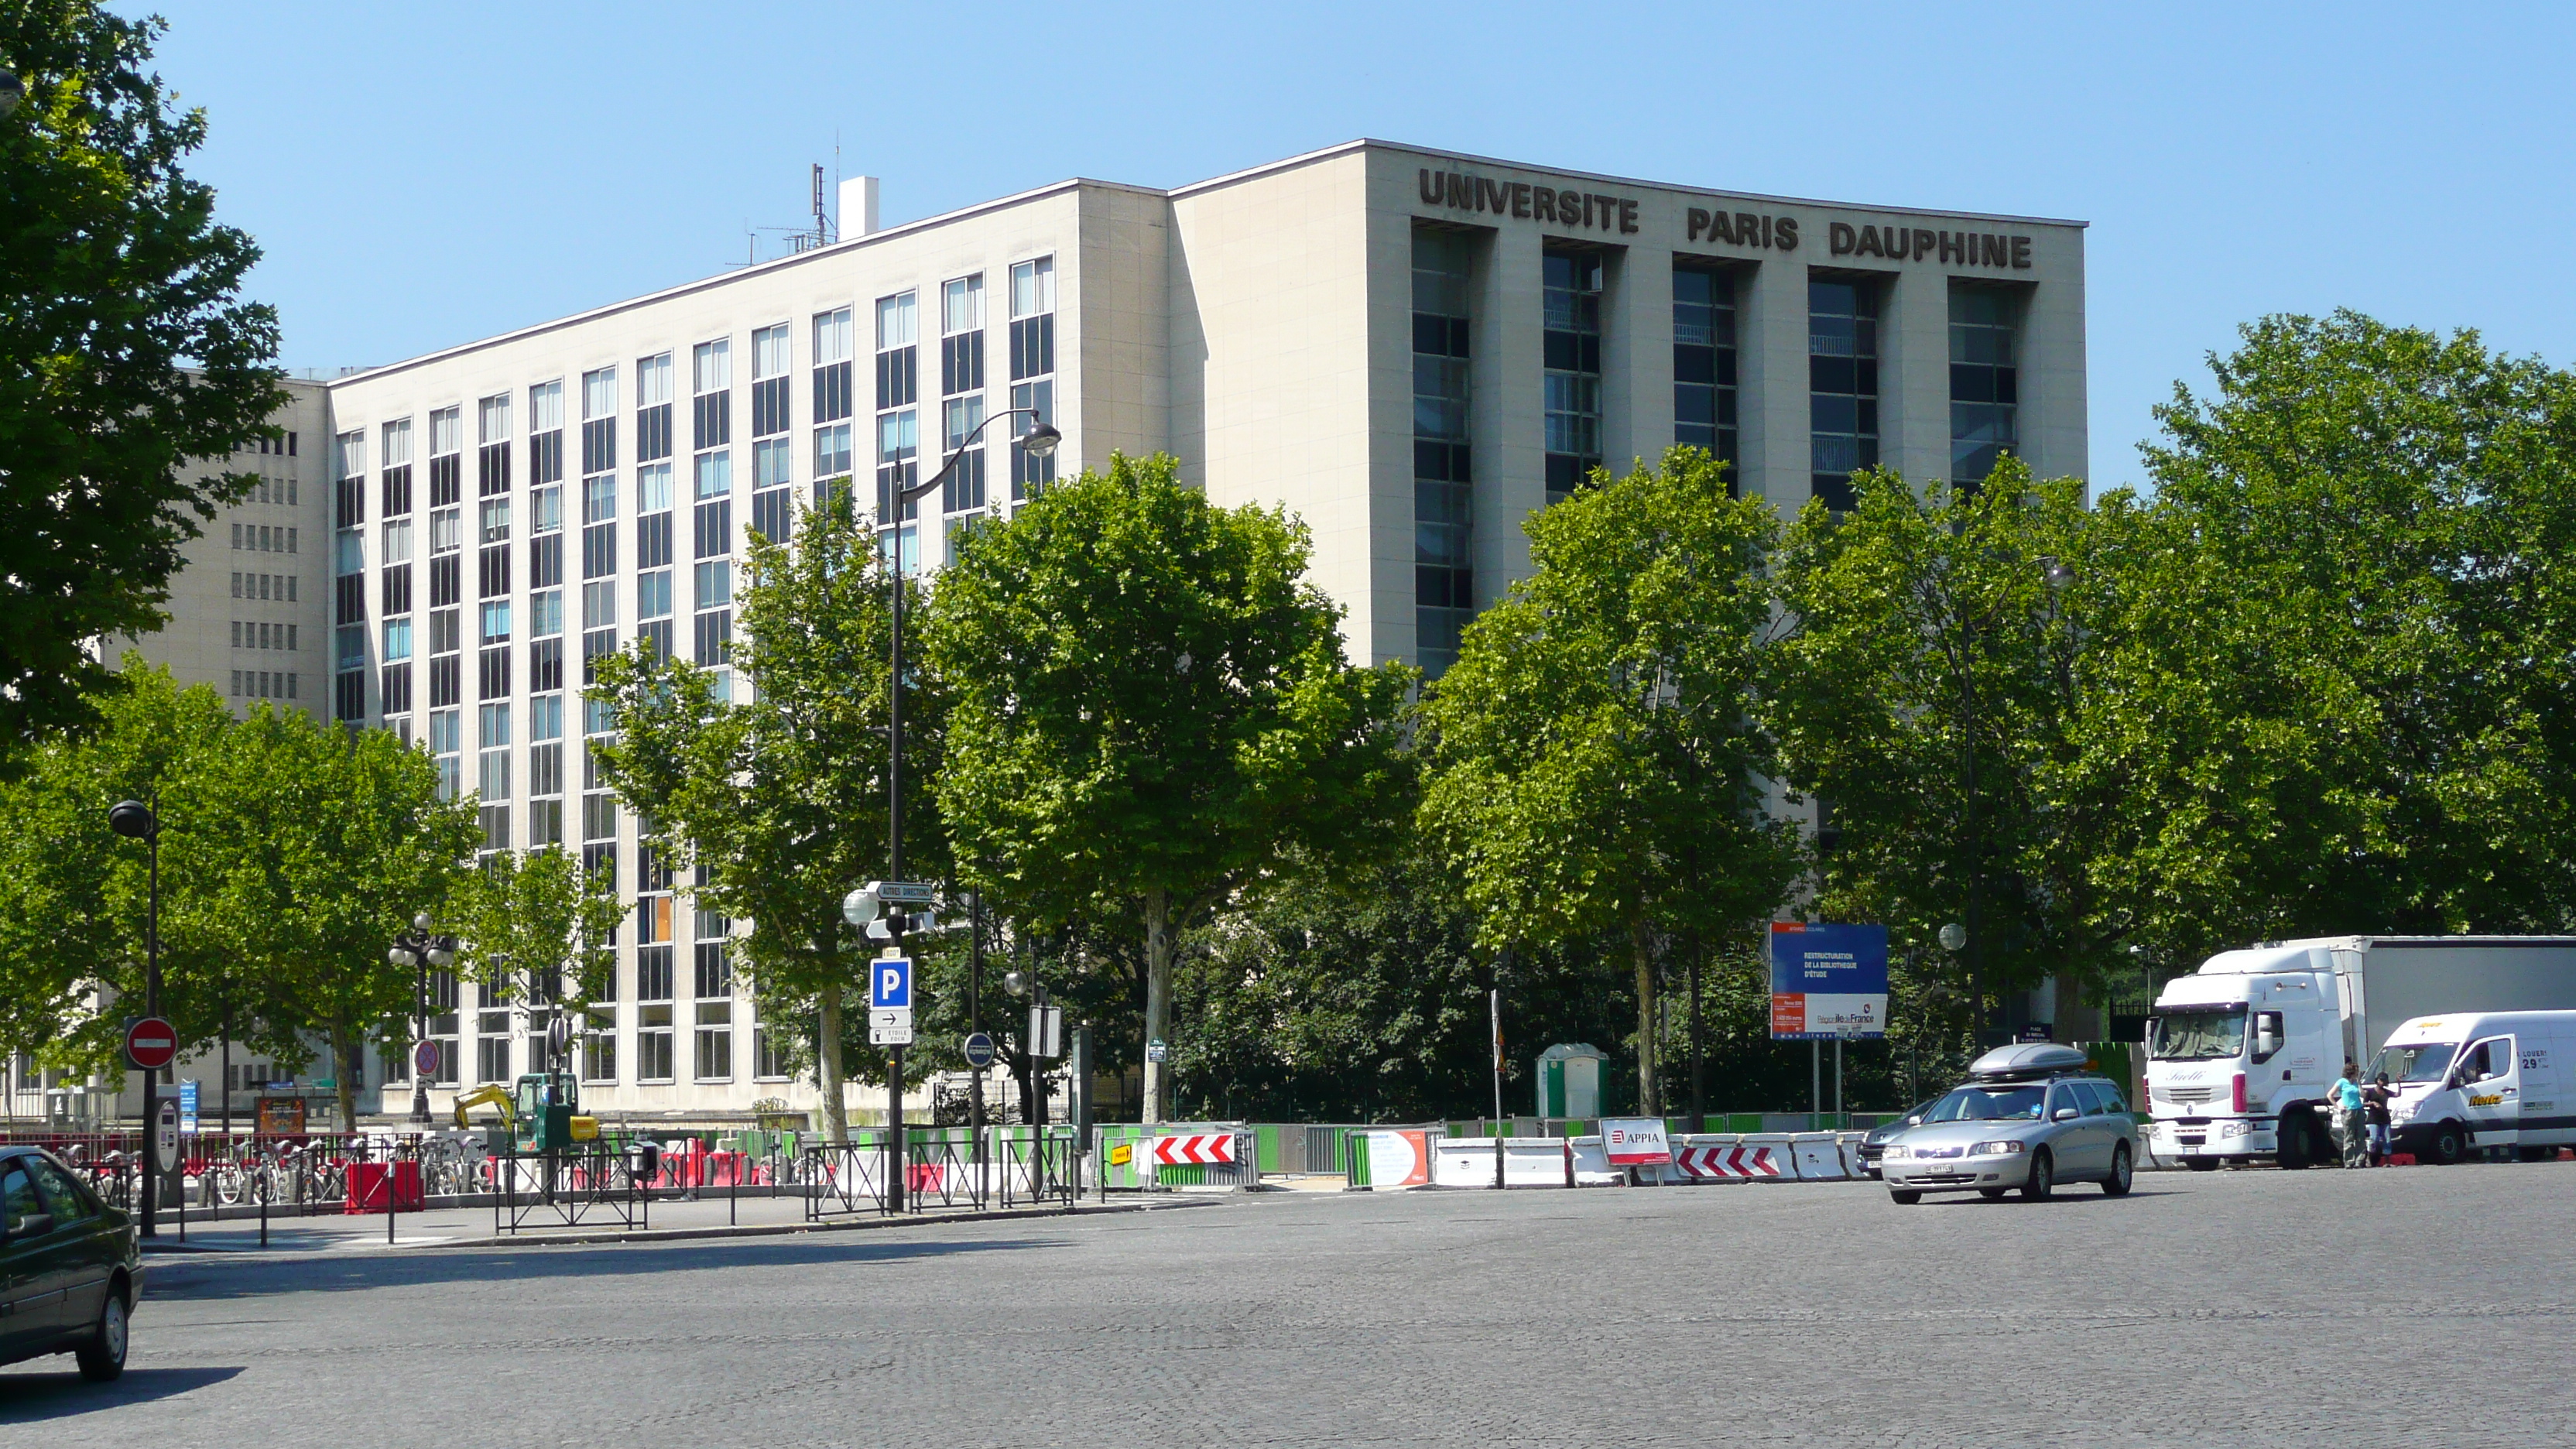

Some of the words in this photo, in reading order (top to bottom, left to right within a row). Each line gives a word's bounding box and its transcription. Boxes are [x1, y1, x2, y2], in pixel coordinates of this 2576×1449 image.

[1420, 168, 1639, 233] UNIVERSITE
[1687, 207, 1799, 251] PARIS
[1830, 221, 2032, 269] DAUPHINE
[883, 969, 900, 1000] P
[2522, 1058, 2537, 1069] 29
[2468, 1094, 2504, 1107] Hertz
[1627, 1133, 1660, 1144] APPIA
